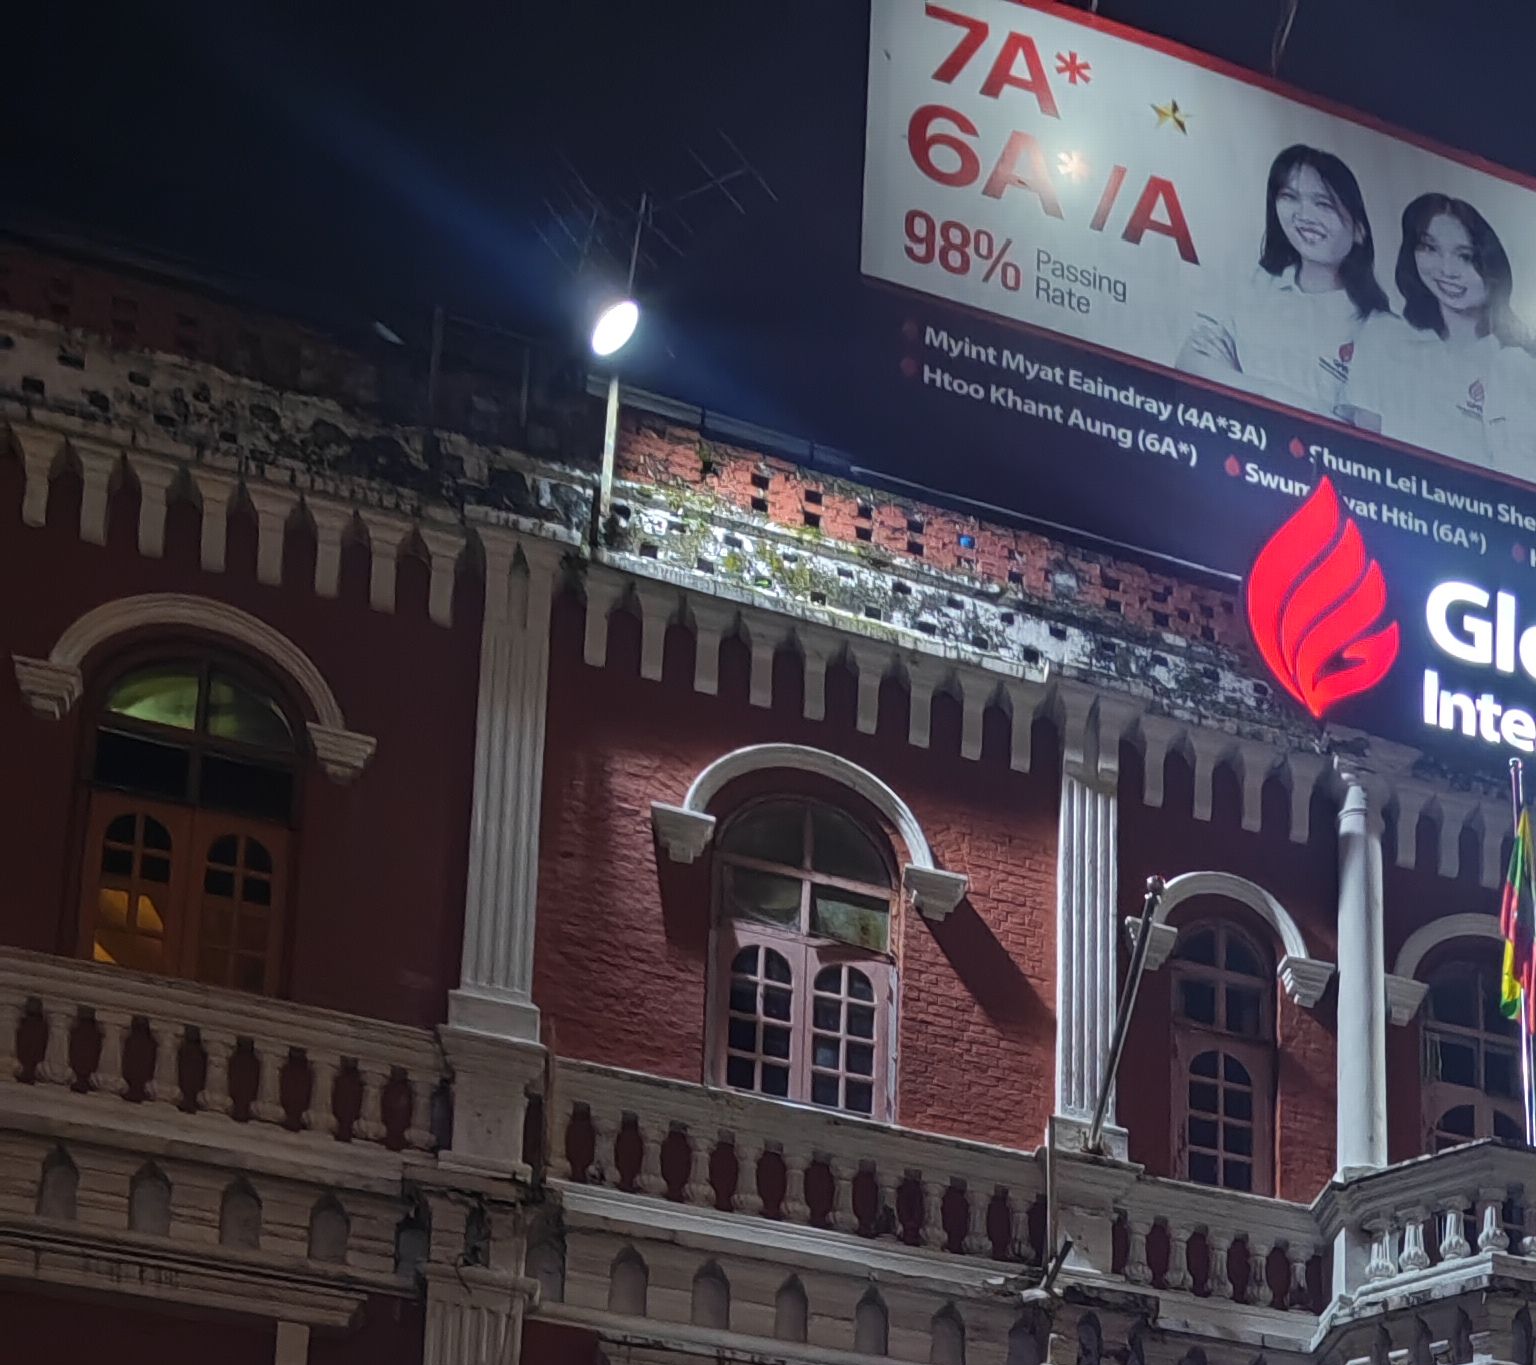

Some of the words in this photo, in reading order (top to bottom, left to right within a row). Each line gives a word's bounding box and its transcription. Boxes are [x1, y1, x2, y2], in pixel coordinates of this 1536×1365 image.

[904, 209, 1021, 292] 98%
[1036, 248, 1127, 303] Passing
[1035, 276, 1091, 315] Rate
[923, 364, 984, 402] Htoo
[990, 384, 1064, 424] Khant
[1067, 407, 1133, 450] Aung
[925, 326, 997, 366] Myint
[1002, 349, 1064, 388] Myat
[1069, 368, 1172, 421] Eaindray
[1309, 445, 1381, 485] Shunn
[1386, 467, 1417, 497] Lei
[1421, 479, 1493, 519] Lawun
[1381, 503, 1428, 536] Htin
